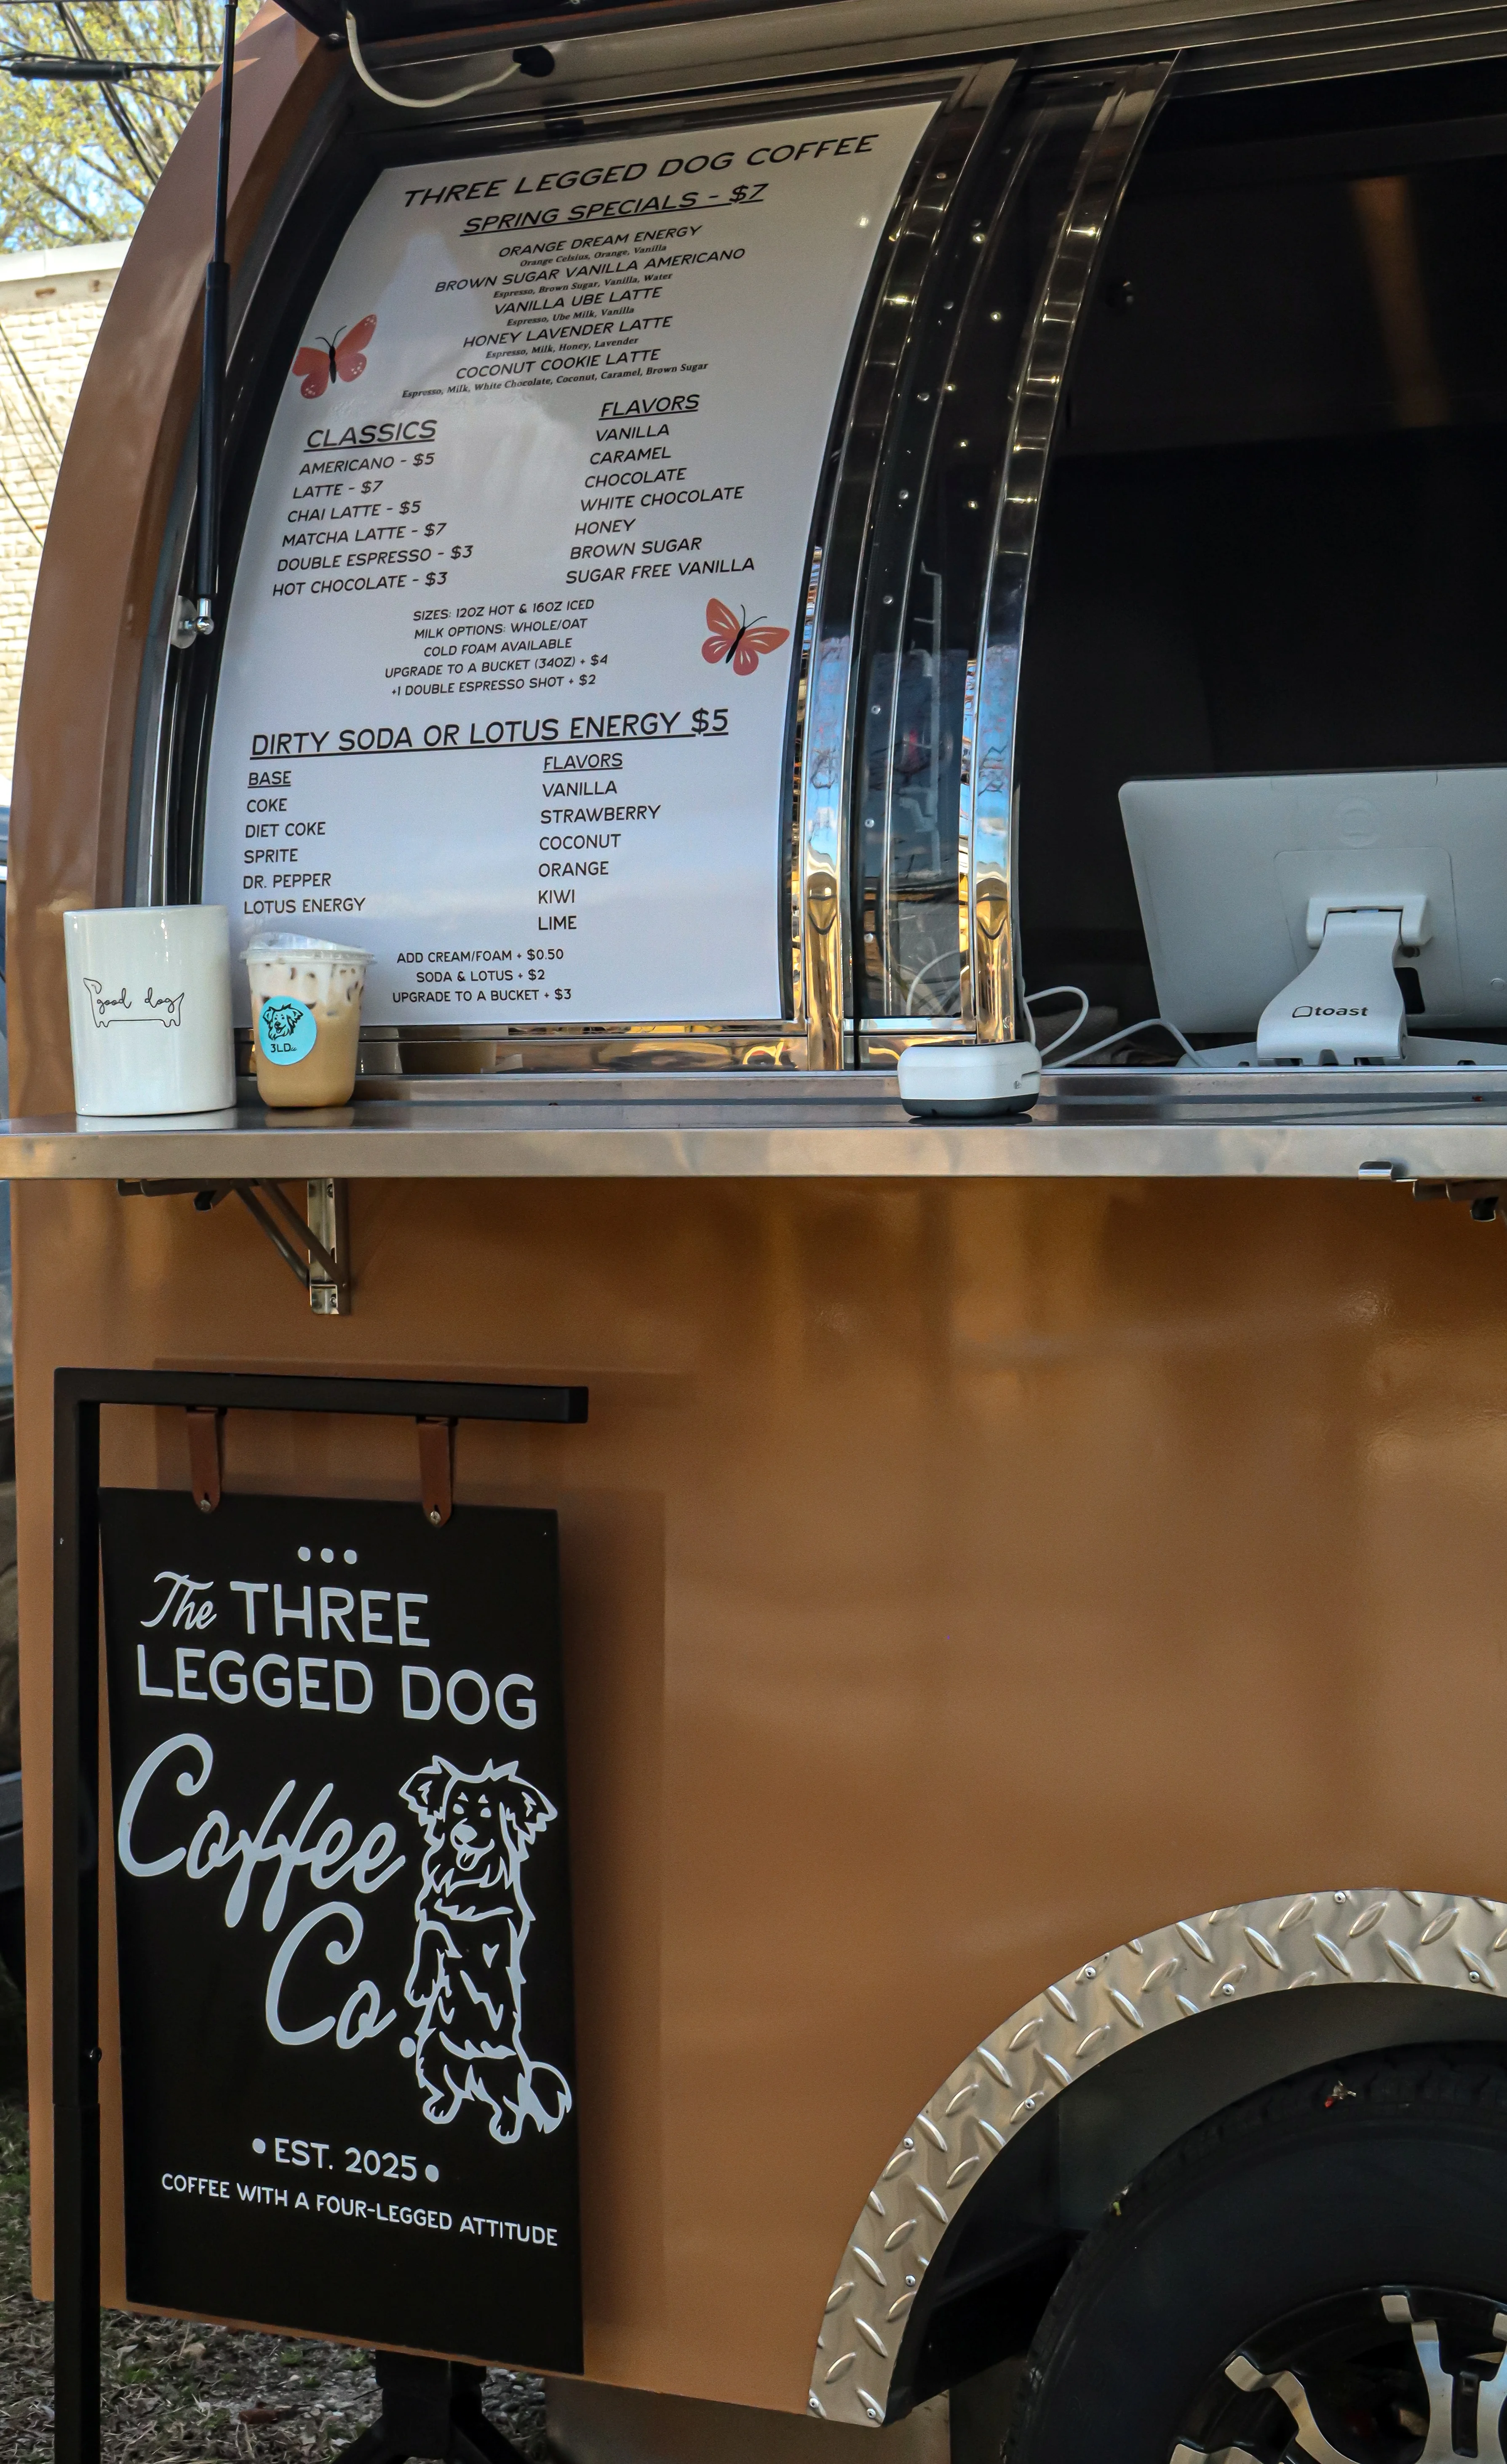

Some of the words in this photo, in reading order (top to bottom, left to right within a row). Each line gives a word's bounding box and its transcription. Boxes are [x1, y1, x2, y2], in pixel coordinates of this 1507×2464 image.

[405, 179, 508, 207] THREE
[514, 163, 647, 194] LEGGED
[657, 152, 735, 177] DOG
[747, 134, 879, 166] COFFEE
[463, 208, 559, 233] SPRING
[567, 192, 699, 221] SPECIALS
[729, 183, 769, 203] $7
[499, 240, 566, 257] ORANGE
[571, 234, 629, 249] DREAM
[634, 225, 703, 242] ENERGY
[520, 259, 553, 267] Orange
[556, 254, 590, 262] Celsius,
[594, 250, 629, 258] Orange,
[635, 244, 666, 253] Vanilla
[435, 276, 497, 292] BROWN
[502, 269, 560, 285] SUGAR
[566, 260, 637, 278] VANILLA
[644, 248, 745, 269] AMERICANO
[493, 289, 535, 299] Espresso,
[539, 285, 568, 293] Brown
[571, 282, 600, 290] Sugar,
[605, 276, 639, 286] Vanilla,
[495, 297, 564, 314] VANILLA
[572, 293, 604, 306] UBE
[609, 287, 663, 302] LATTE
[507, 317, 548, 327] Espresso,
[573, 310, 597, 318] Milk,
[602, 307, 634, 315] Vanilla
[463, 331, 522, 347] HONEY
[526, 322, 614, 341] LAVENDER
[619, 316, 673, 332] LATTE
[486, 350, 528, 359] Espresso,
[532, 345, 555, 353] Milk,
[594, 337, 639, 347] Lavender
[457, 361, 536, 379] COCONUT
[541, 355, 601, 371] COOKIE
[606, 349, 661, 365] LATTE
[402, 390, 443, 399] Espresso,
[505, 378, 553, 388] Chocolate,
[556, 374, 597, 383] Coconut,
[601, 368, 642, 379] Caramel,
[646, 367, 677, 375] Brown
[680, 363, 708, 372] Sugar
[599, 394, 700, 421] FLAVORS
[307, 419, 437, 448] CLASSICS
[596, 424, 669, 441] VANILLA
[299, 456, 394, 475] AMERICANO
[413, 453, 435, 467] $5
[590, 447, 671, 465] CARAMEL
[585, 467, 687, 488] CHOCOLATE
[293, 483, 344, 499] LATTE
[361, 480, 383, 494] $7
[581, 495, 635, 511] WHITE
[641, 486, 744, 507] CHOCOLATE
[288, 509, 325, 523] CHAI
[331, 504, 381, 519] LATTE
[399, 501, 421, 515] $5
[282, 531, 348, 547] MATCHA
[355, 526, 406, 542] LATTE
[424, 523, 447, 537] $7
[575, 518, 636, 535] HONEY
[278, 555, 342, 571] DOUBLE
[347, 548, 431, 566] ESPRESSO
[450, 545, 473, 560] $3
[570, 542, 635, 559] BROWN
[641, 537, 702, 554] SUGAR
[566, 567, 625, 584] SUGAR
[631, 563, 672, 579] FREE
[679, 558, 754, 575] VANILLA
[273, 582, 306, 596] HOT
[311, 575, 407, 593] CHOCOLATE
[425, 571, 448, 587] $3
[413, 609, 452, 621] SIZES:
[457, 606, 485, 618] 12OZ
[489, 605, 515, 616] HOT
[519, 603, 527, 614] &
[533, 601, 563, 612] 16OZ
[567, 599, 594, 610] ICED
[414, 628, 444, 639] MILK
[448, 624, 506, 637] OPTIONS:
[511, 618, 588, 633] WHOLE/OAT
[424, 646, 457, 657] COLD
[462, 643, 496, 654] FOAM
[500, 638, 572, 652] AVAILABLE
[385, 665, 443, 678] UPGRADE
[447, 664, 463, 674] TO
[468, 663, 476, 673] A
[482, 659, 530, 672] BUCKET
[535, 657, 575, 669] (34OZ)
[591, 654, 607, 666] $4
[392, 686, 401, 696] +1
[405, 683, 455, 695] DOUBLE
[459, 679, 524, 692] ESPRESSO
[529, 676, 564, 688] SHOT
[579, 674, 596, 686] $2
[252, 731, 329, 755] DIRTY
[339, 727, 412, 751] SODA
[424, 724, 460, 747] OR
[470, 718, 558, 744] LOTUS
[570, 712, 681, 739] ENERGY
[691, 707, 729, 735] $5
[543, 753, 623, 773] FLAVORS
[248, 771, 291, 788] BASE
[542, 781, 617, 797] VANILLA
[247, 798, 287, 813] COKE
[541, 805, 661, 824] STRAWBERRY
[246, 824, 279, 838] DIET
[285, 822, 326, 836] COKE
[540, 834, 621, 850] COCONUT
[244, 849, 298, 864] SPRITE
[539, 861, 609, 877] ORANGE
[243, 876, 267, 889] DR.
[273, 873, 331, 888] PEPPER
[244, 900, 296, 914] LOTUS
[303, 898, 366, 912] ENERGY
[539, 889, 574, 904] KIWI
[539, 916, 577, 930] LIME
[397, 953, 423, 963] ADD
[428, 950, 512, 962] CREAM/FOAM
[527, 948, 564, 961] $0.50
[417, 972, 452, 982] SODA
[457, 971, 465, 982] &
[471, 970, 513, 981] LOTUS
[528, 969, 545, 981] $2
[97, 988, 132, 1014] good
[144, 987, 184, 1013] dog
[393, 991, 451, 1003] UPGRADE
[455, 991, 472, 1001] TO
[477, 991, 486, 1001] A
[491, 990, 539, 1001] BUCKET
[555, 988, 571, 1001] $3
[1315, 1006, 1369, 1016] toast
[141, 1572, 217, 1630] The
[230, 1581, 429, 1647] THREE
[137, 1644, 373, 1714] LEGGED
[401, 1666, 536, 1730] DOG
[118, 1733, 406, 1932] Coffee
[266, 1901, 416, 2058] Co.
[275, 2138, 333, 2170] EST.
[345, 2147, 417, 2181] 2025
[162, 2173, 230, 2198] COFFEE
[237, 2183, 287, 2206] WITH
[295, 2192, 309, 2210] A
[317, 2194, 452, 2230] FOUR-LEGGED
[460, 2216, 557, 2246] ATTITUDE
